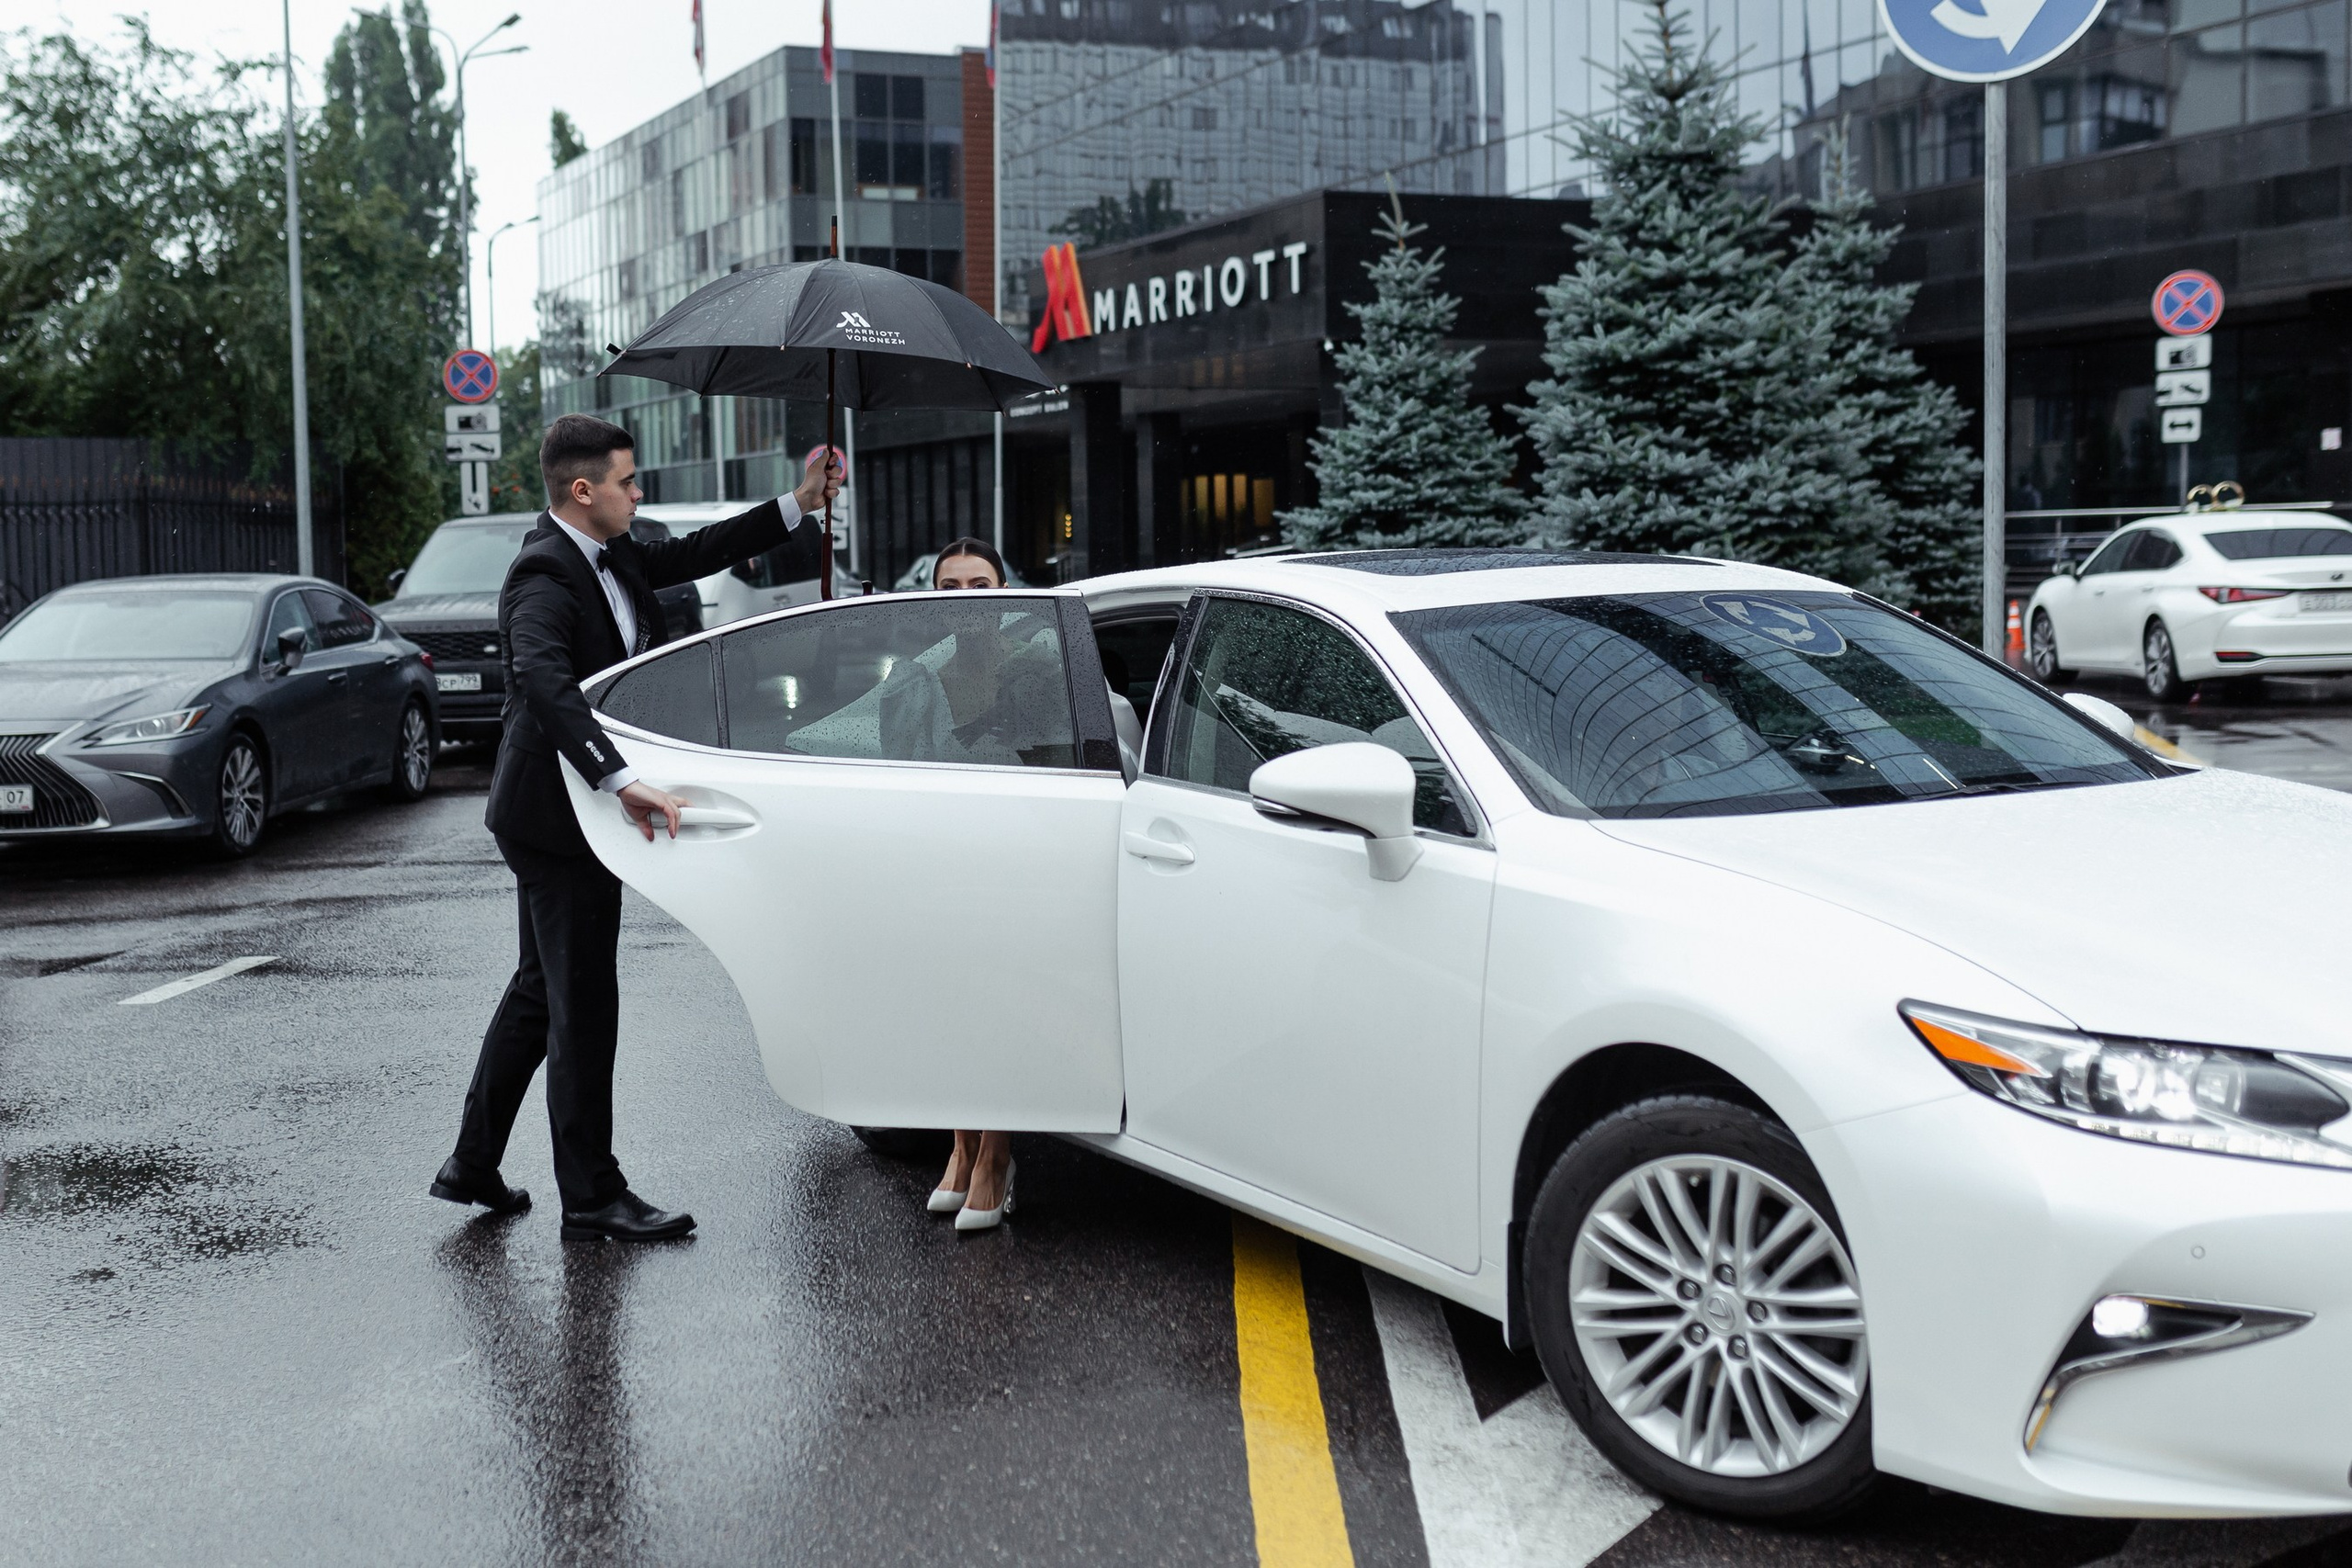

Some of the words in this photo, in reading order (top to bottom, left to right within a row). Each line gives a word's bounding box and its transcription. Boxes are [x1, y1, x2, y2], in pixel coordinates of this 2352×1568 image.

[1092, 242, 1307, 334] MARRIOTT
[845, 328, 900, 338] MARRIOTT
[846, 334, 906, 344] VORONEZH
[6, 791, 24, 804] 07
